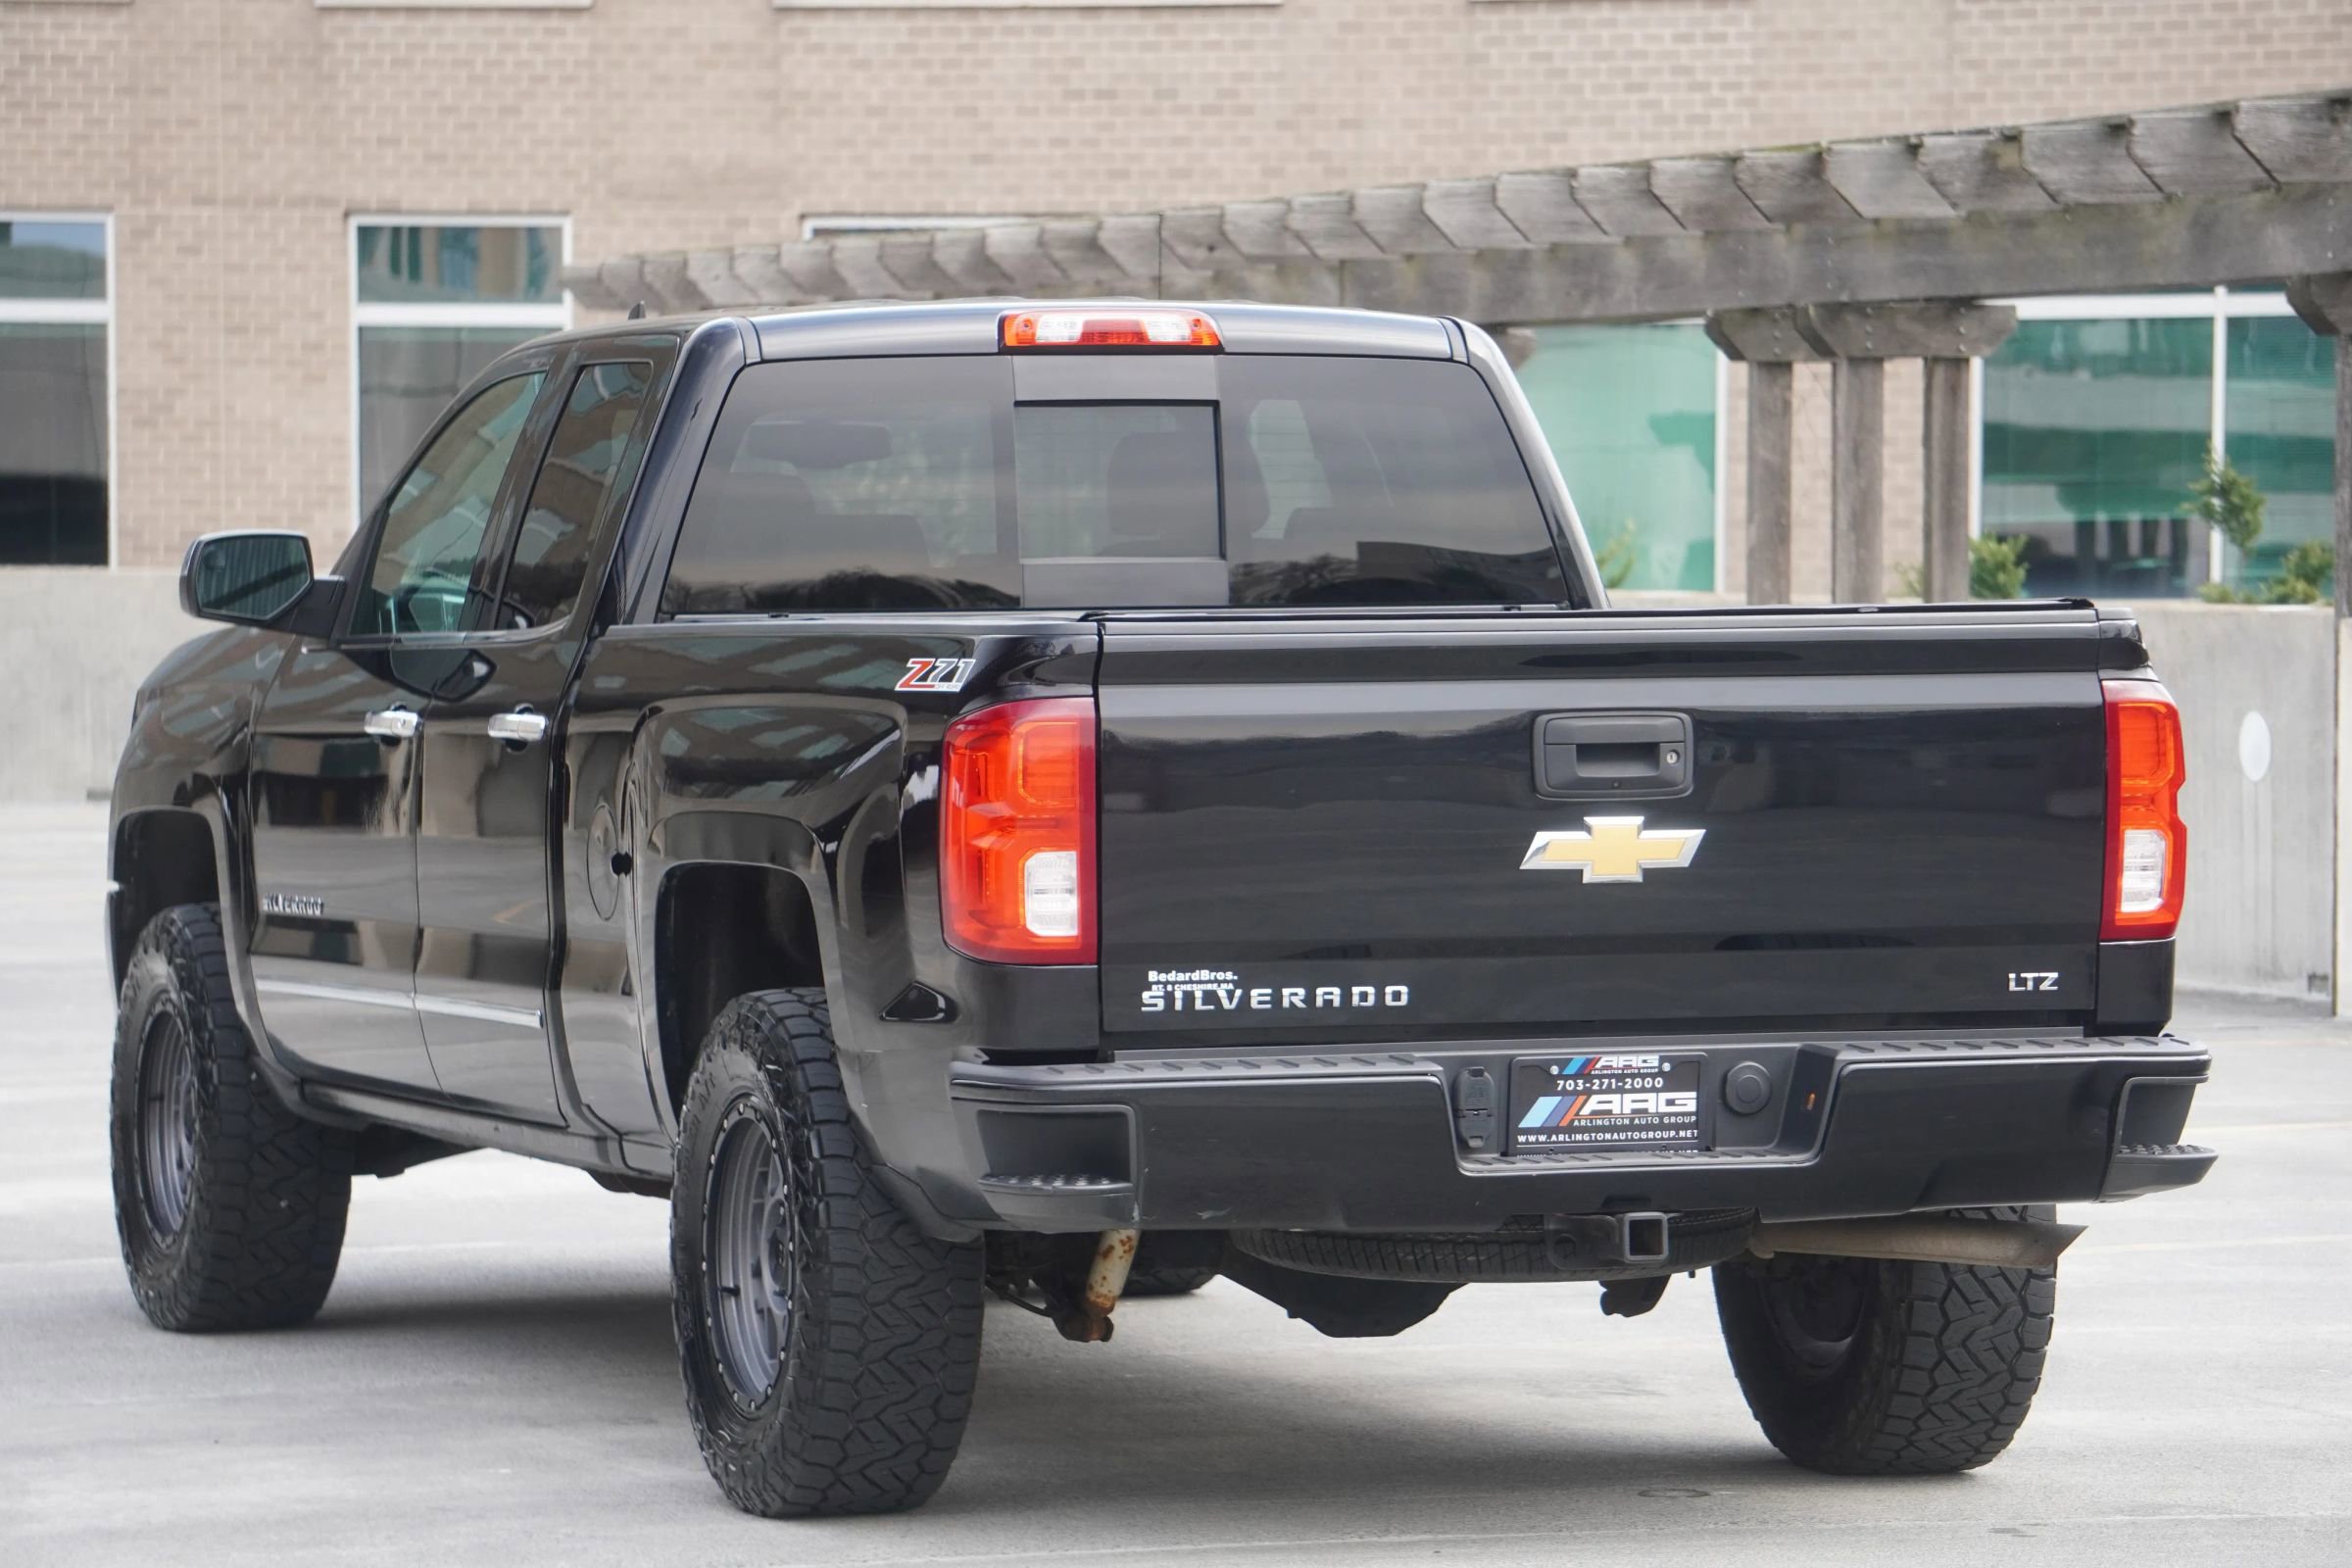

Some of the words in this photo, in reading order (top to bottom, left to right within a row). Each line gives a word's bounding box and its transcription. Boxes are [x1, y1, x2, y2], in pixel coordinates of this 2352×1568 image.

[894, 658, 976, 692] Z71
[1148, 969, 1239, 982] BedardBros.
[2008, 972, 2059, 992] LTZ
[1141, 985, 1409, 1011] SILVERADO
[1594, 1055, 1660, 1069] AAG
[1556, 1077, 1664, 1091] 703-271-2000
[1579, 1092, 1697, 1115] AAG
[1573, 1117, 1630, 1126] ARLINGTON
[1634, 1116, 1660, 1125] AUTO
[1663, 1115, 1697, 1124] GROUP
[1517, 1129, 1698, 1143] WWW.ARLINGTONAUTOGROUP.NET
